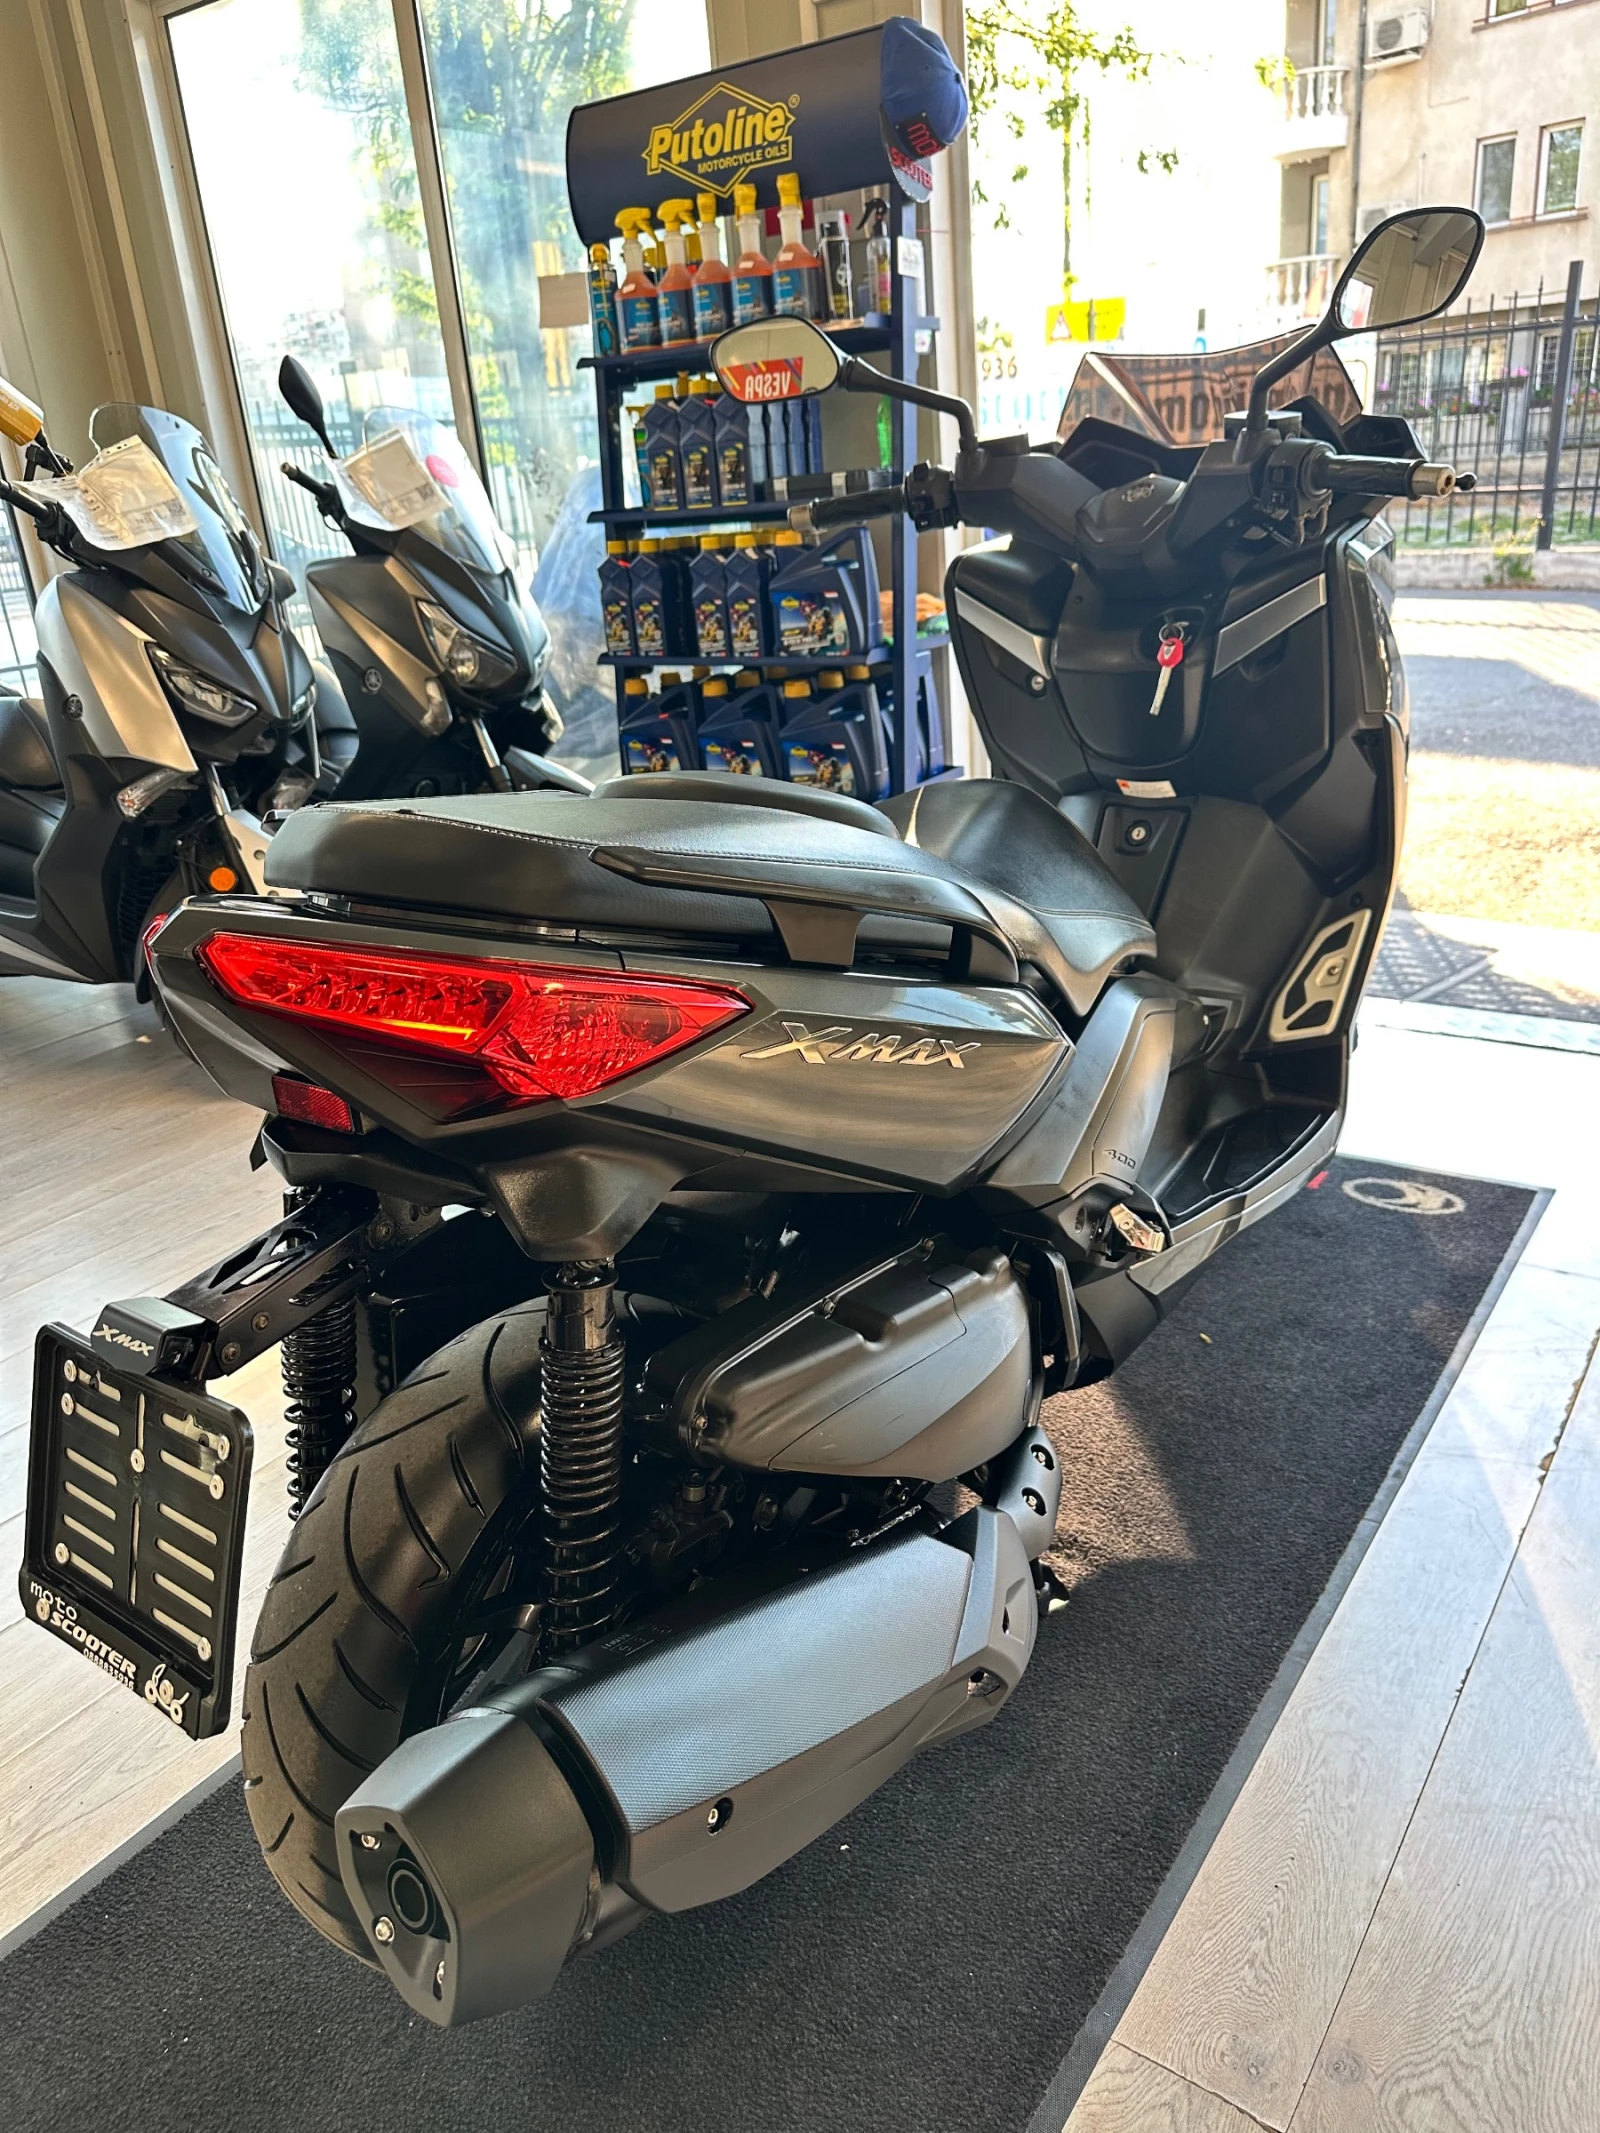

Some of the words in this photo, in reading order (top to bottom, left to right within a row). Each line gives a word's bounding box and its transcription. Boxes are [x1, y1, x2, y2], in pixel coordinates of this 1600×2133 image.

[651, 105, 786, 170] Putoline
[697, 149, 763, 174] MOTORCYCLE
[764, 144, 788, 159] OILS
[1103, 1148, 1137, 1170] 400
[30, 1580, 78, 1621] moto
[50, 1610, 137, 1680] SCOOTER
